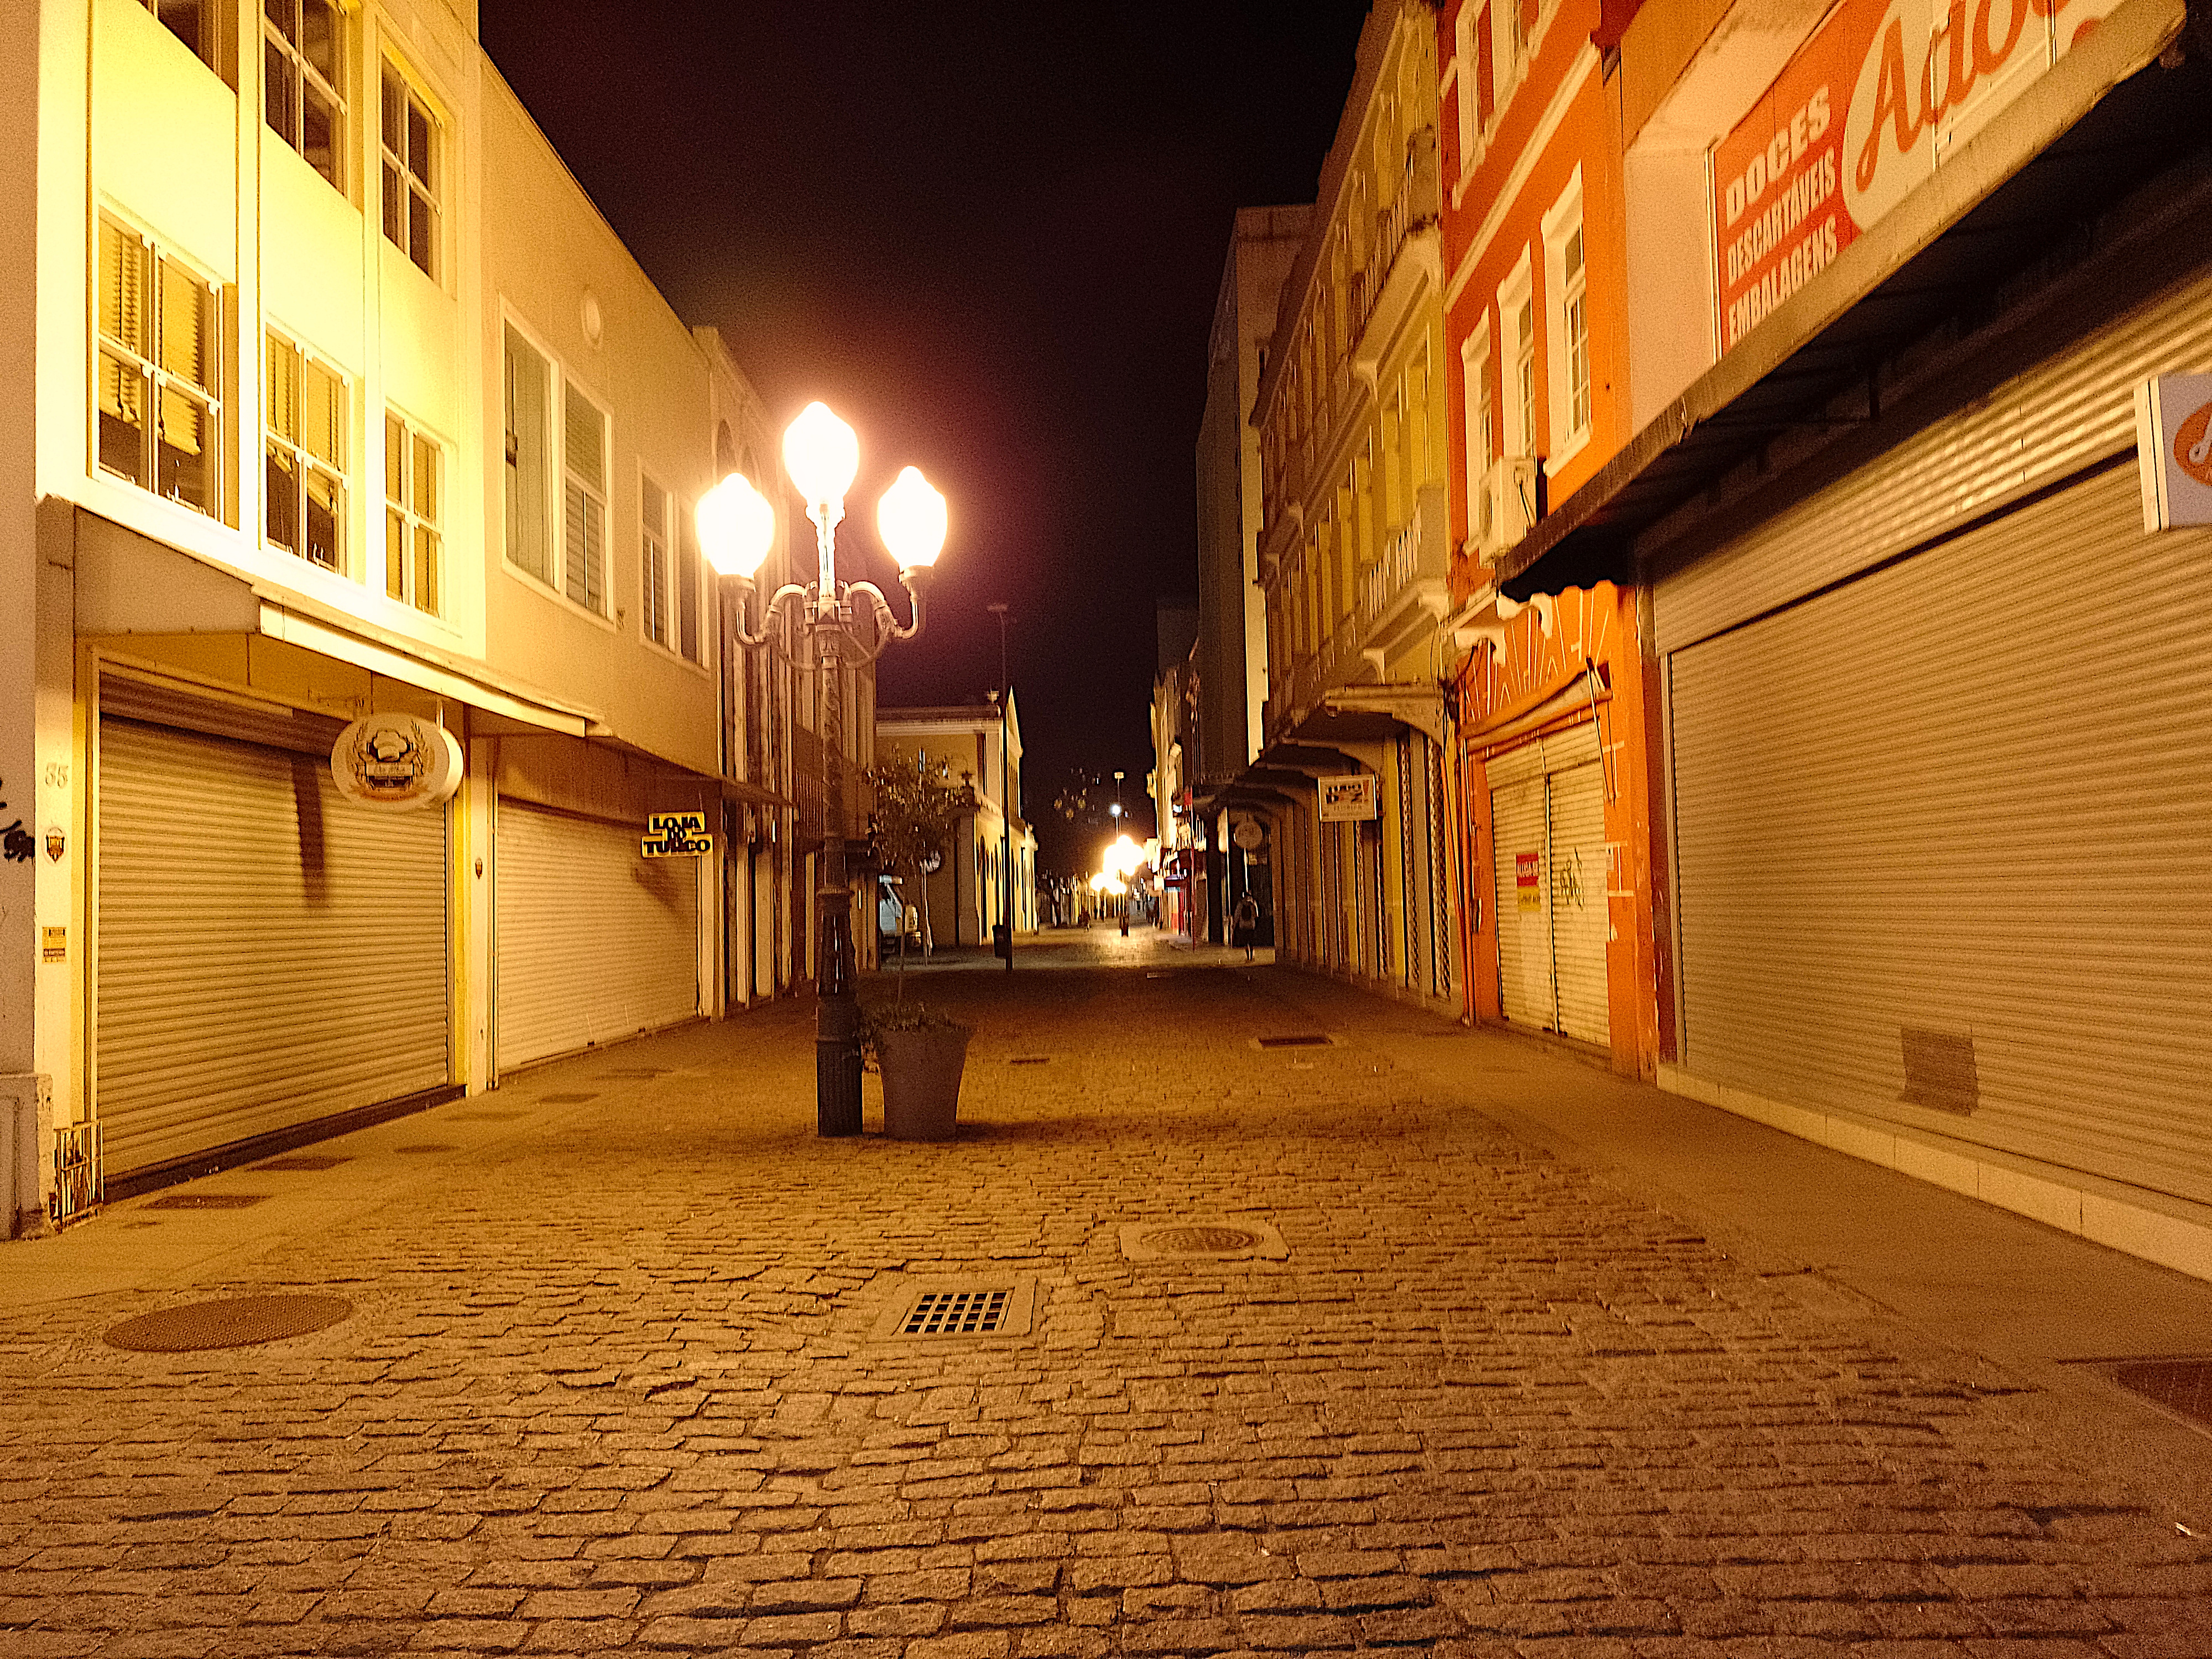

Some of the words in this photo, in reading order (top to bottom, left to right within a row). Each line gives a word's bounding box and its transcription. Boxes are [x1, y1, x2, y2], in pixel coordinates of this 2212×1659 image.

[1726, 85, 1831, 228] DOCES
[1728, 147, 1836, 288] DESCARTÁVEIS
[1729, 214, 1837, 347] EMBALAGENS
[643, 839, 711, 854] TURCO
[652, 816, 702, 830] LOJA
